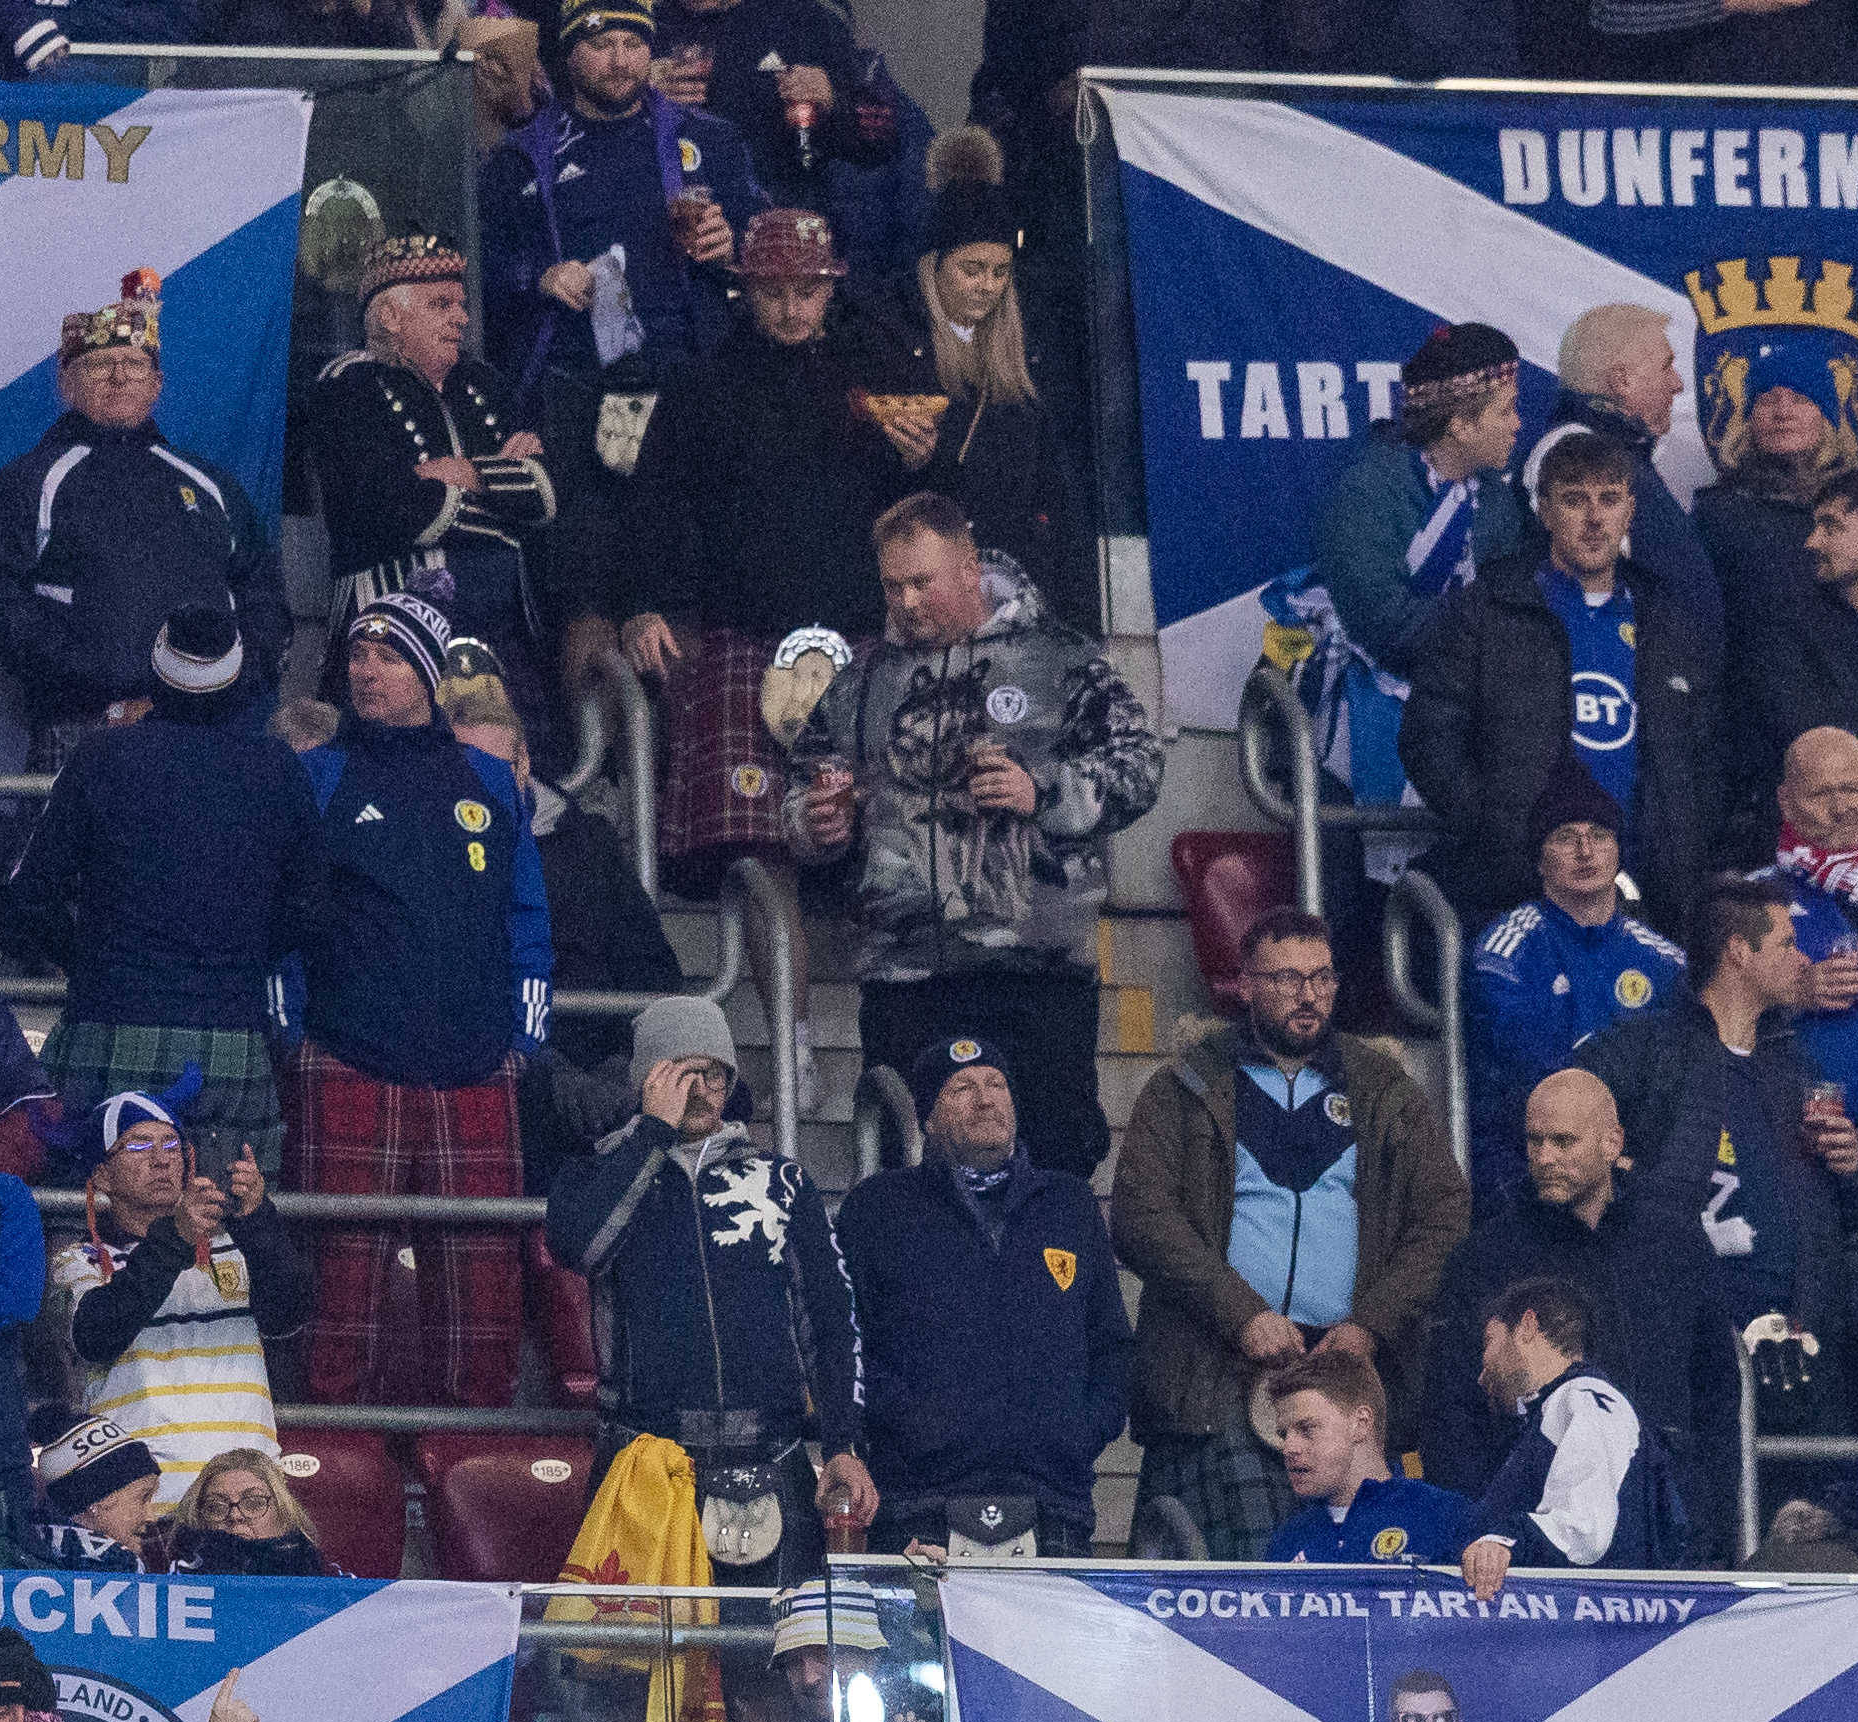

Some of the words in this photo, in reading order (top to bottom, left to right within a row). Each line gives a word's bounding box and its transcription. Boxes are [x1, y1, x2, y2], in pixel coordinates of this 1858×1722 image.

[1186, 359, 1402, 440] TART
[1576, 695, 1622, 724] BT
[540, 1466, 562, 1478] 185
[1147, 1588, 1369, 1620] COCKTAIL
[1379, 1590, 1558, 1621] TARTAN
[1573, 1596, 1696, 1624] ARMY
[56, 1682, 133, 1722] LAND
